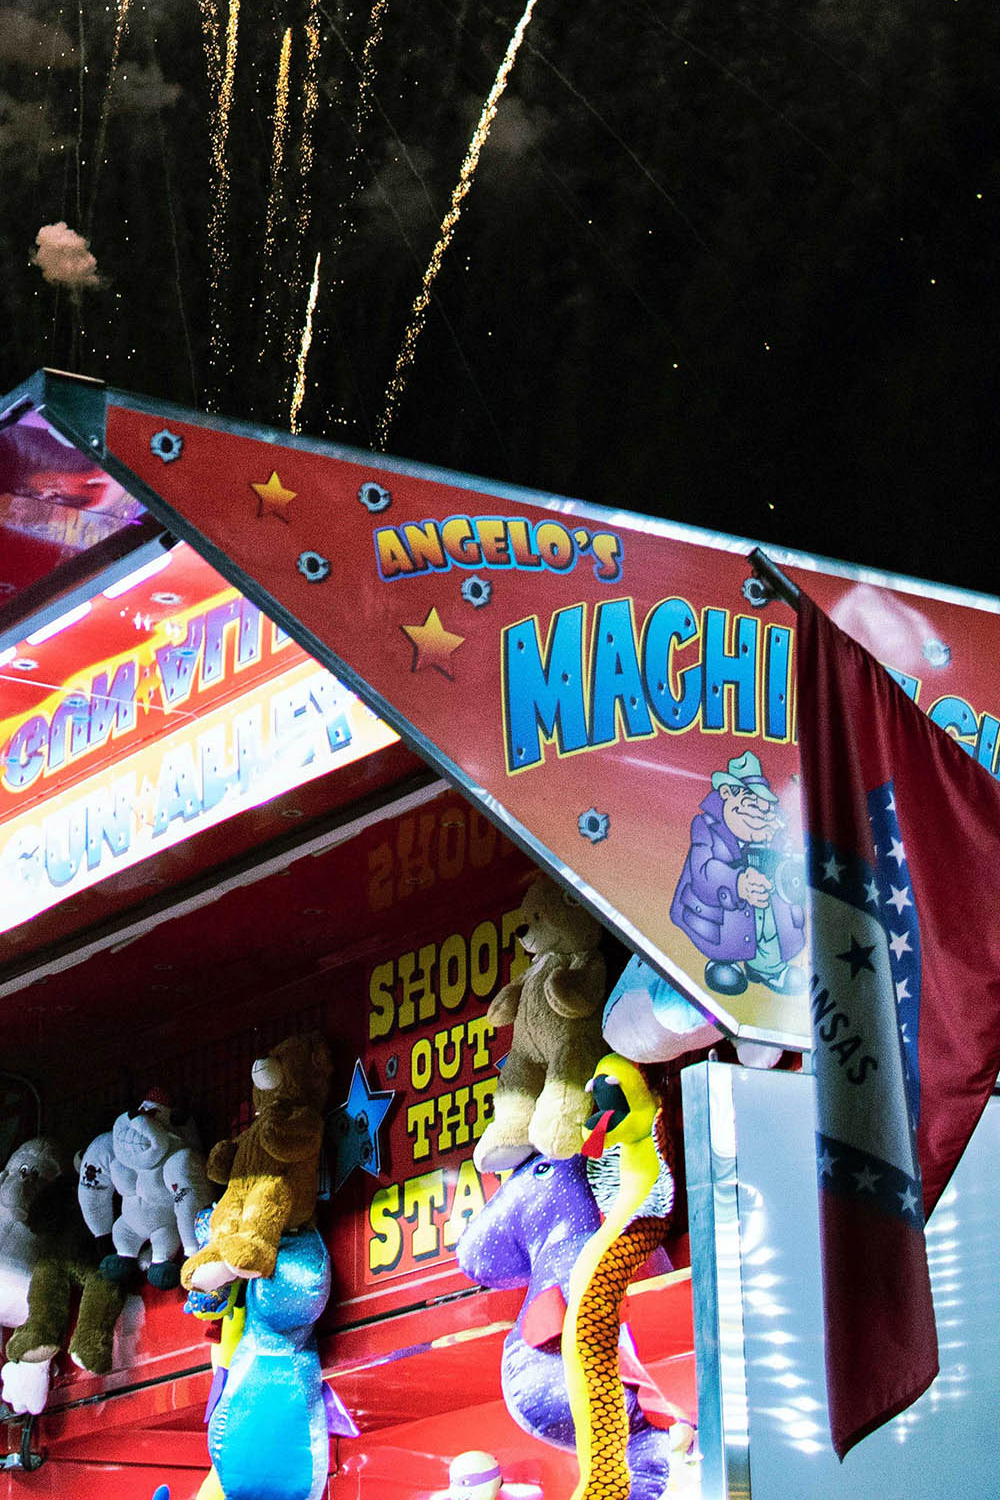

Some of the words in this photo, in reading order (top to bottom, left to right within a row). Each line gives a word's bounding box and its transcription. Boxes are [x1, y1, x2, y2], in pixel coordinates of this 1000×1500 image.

[374, 515, 624, 582] ANGELO'S
[501, 596, 922, 777] MACHI
[410, 1013, 496, 1092] OUT
[810, 974, 878, 1085] NSAS
[368, 1158, 513, 1274] STA
